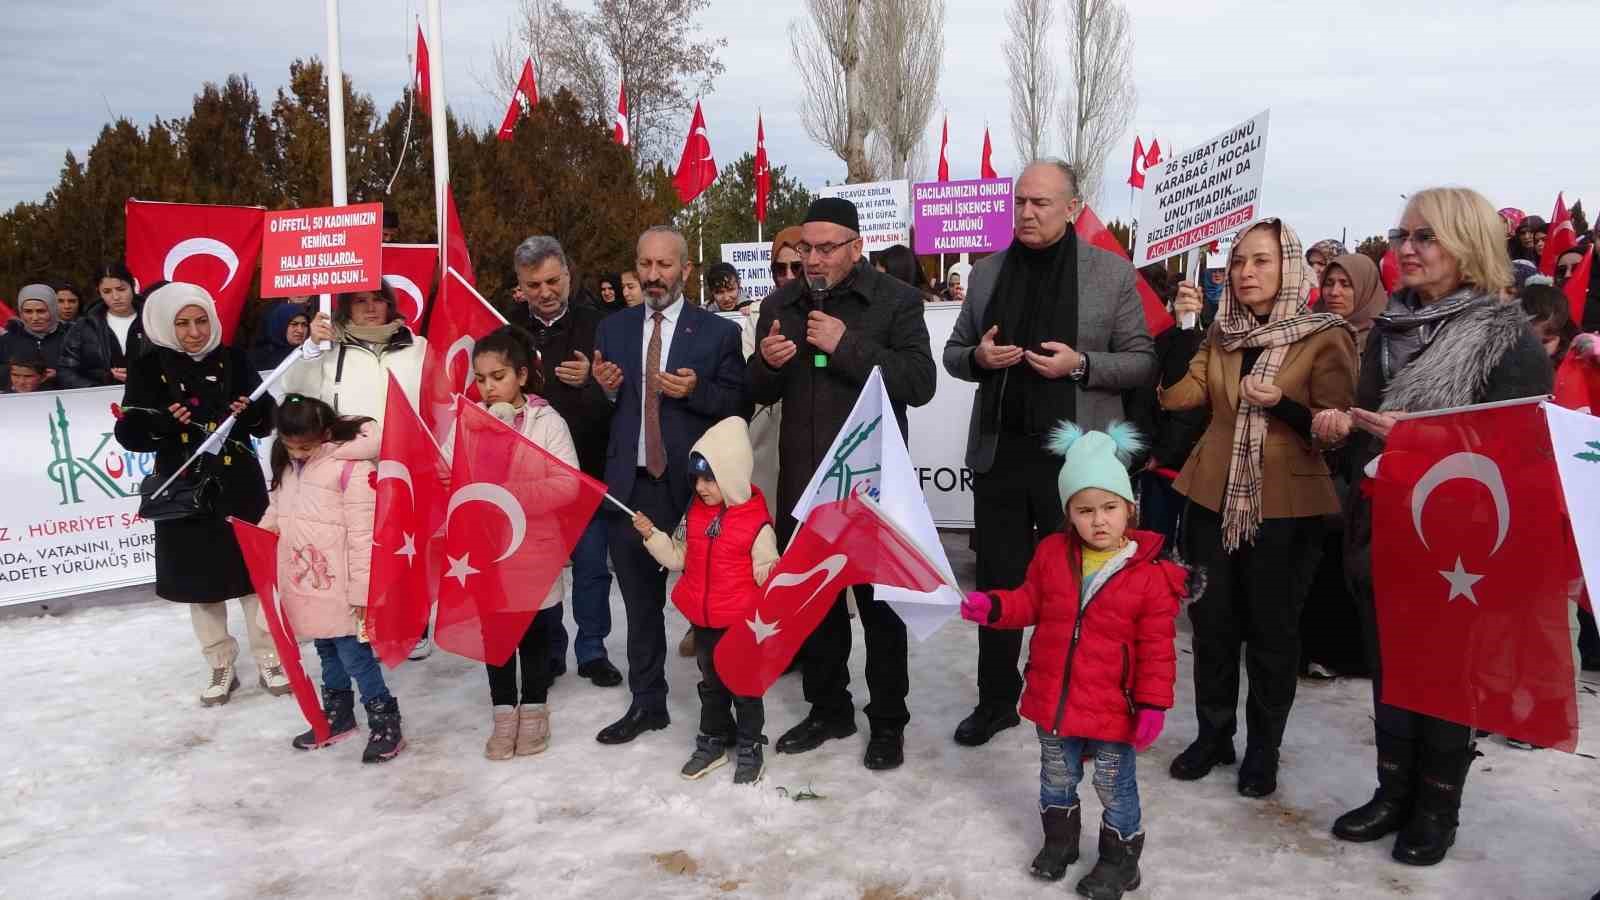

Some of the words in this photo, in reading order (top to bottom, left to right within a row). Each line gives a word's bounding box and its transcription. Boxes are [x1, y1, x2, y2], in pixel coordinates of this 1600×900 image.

[1166, 161, 1178, 175] 26
[1181, 141, 1218, 170] ŞUBAT
[1220, 120, 1255, 148] GÜNÜ
[1154, 160, 1208, 195] KARABAĞ
[1218, 135, 1261, 167] HOCALI
[837, 190, 866, 199] TECAVÜZ
[868, 187, 890, 196] EDİLEN
[917, 185, 977, 200] BACILARIMIZIN
[980, 183, 1009, 195] ONURU
[1159, 168, 1232, 208] KADINLARINI
[1235, 159, 1251, 175] DA
[922, 202, 952, 216] ERMENİ
[955, 200, 991, 217] İŞKENCE
[993, 201, 1005, 212] VE
[1164, 184, 1242, 222] UNUTMADIK...
[271, 220, 277, 232] O
[313, 216, 323, 229] 50
[324, 212, 376, 228] KADINIMIZIN
[942, 216, 983, 232] ZULMÜNÜ
[1147, 225, 1174, 243] BİZLER
[1176, 215, 1192, 234] İÇİN
[1194, 207, 1212, 225] GÜN
[1214, 188, 1257, 218] AĞARMADI
[892, 222, 906, 231] İÇİN
[301, 231, 346, 249] KEMİKLERİ
[866, 234, 899, 243] YAPILSIN
[935, 236, 982, 248] KALDIRMAZ
[1150, 236, 1187, 258] ACILARI
[280, 255, 303, 268] HALA
[304, 254, 316, 266] BU
[733, 248, 758, 262] ERMENİ
[274, 274, 310, 288] RUHLARI
[312, 272, 329, 289] ŞAD
[331, 270, 359, 285] OLSUN
[748, 268, 766, 279] ANITI
[914, 468, 976, 492] FOR
[29, 514, 114, 537] HÜRRİYET
[121, 512, 148, 529] ŞA
[36, 540, 114, 559] VATANINI,
[52, 554, 128, 575] YÜRÜMÜŞ
